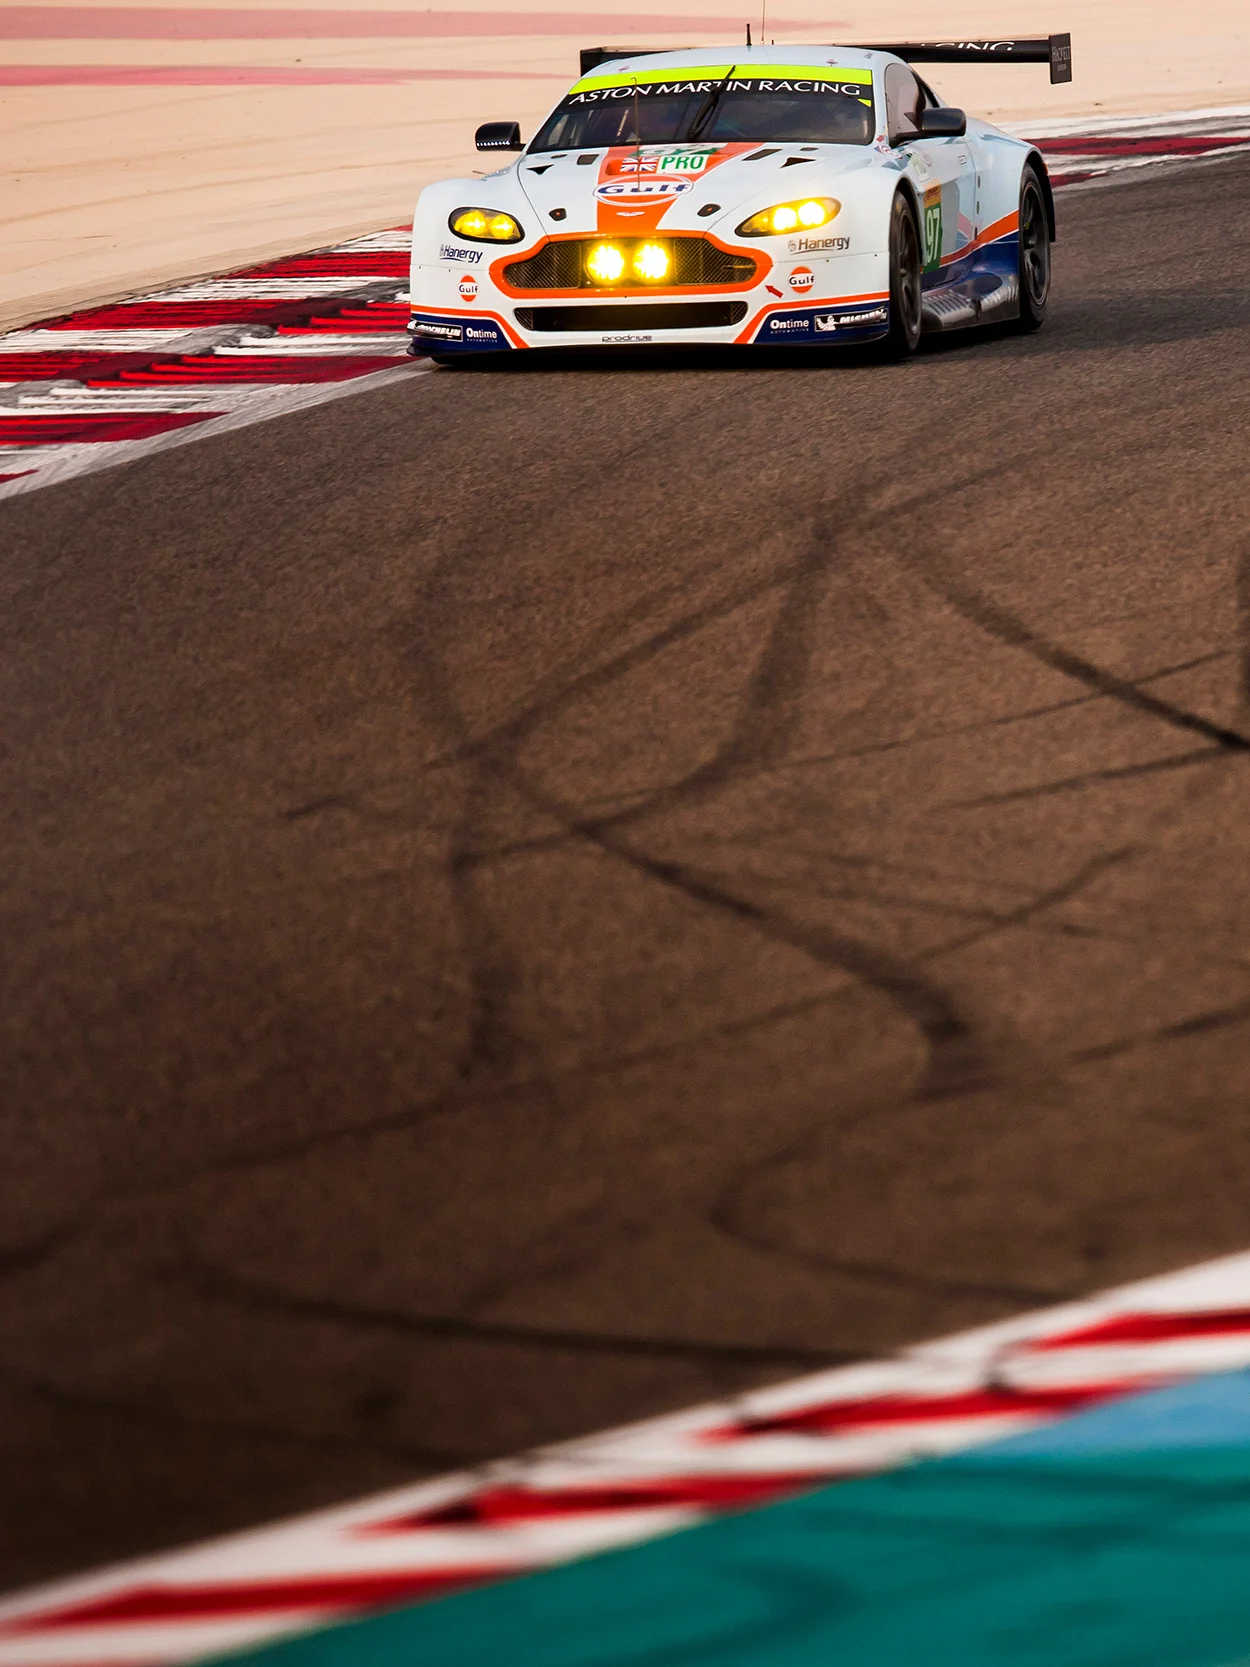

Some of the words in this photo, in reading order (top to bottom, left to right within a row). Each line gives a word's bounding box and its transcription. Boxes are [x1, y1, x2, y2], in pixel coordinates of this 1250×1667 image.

[568, 85, 652, 105] ASTON
[656, 81, 752, 95] MARTIN
[758, 80, 860, 96] RACING
[661, 155, 704, 170] PRO
[597, 184, 690, 194] Gulf
[926, 207, 940, 263] 97
[798, 236, 851, 251] Hanergy
[443, 244, 483, 264] Hanergy
[789, 275, 815, 286] Gulf
[459, 284, 478, 294] Gulf
[770, 318, 809, 330] Ontime
[466, 327, 498, 339] Ontime
